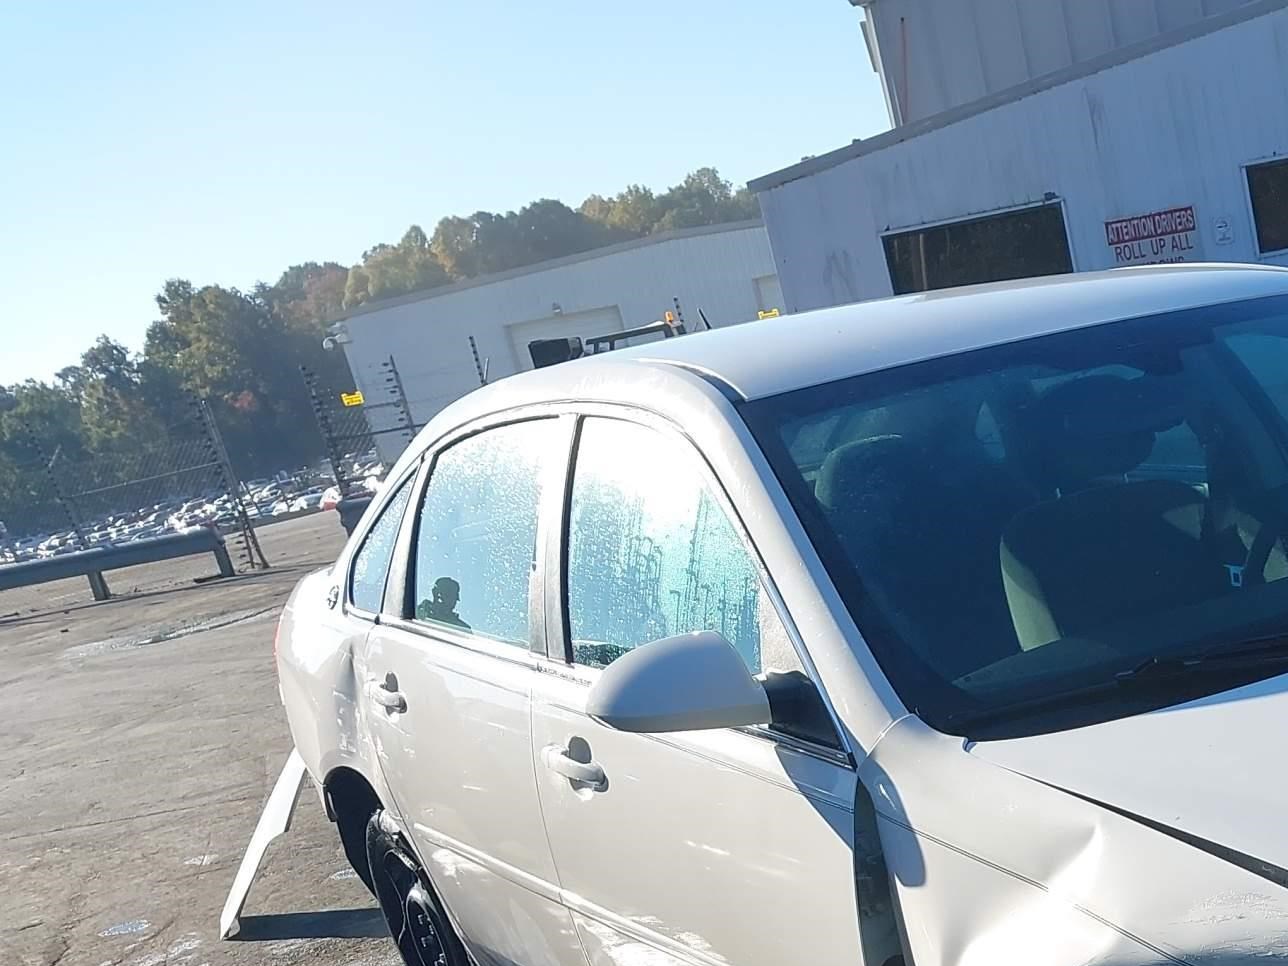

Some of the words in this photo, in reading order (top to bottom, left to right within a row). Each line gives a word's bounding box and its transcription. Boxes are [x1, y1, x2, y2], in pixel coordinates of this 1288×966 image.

[1108, 216, 1154, 243] ATTENTION
[1155, 209, 1194, 234] DRIVERS
[1115, 243, 1146, 262] ROLL
[1151, 238, 1166, 256] UP
[1172, 234, 1193, 252] ALL
